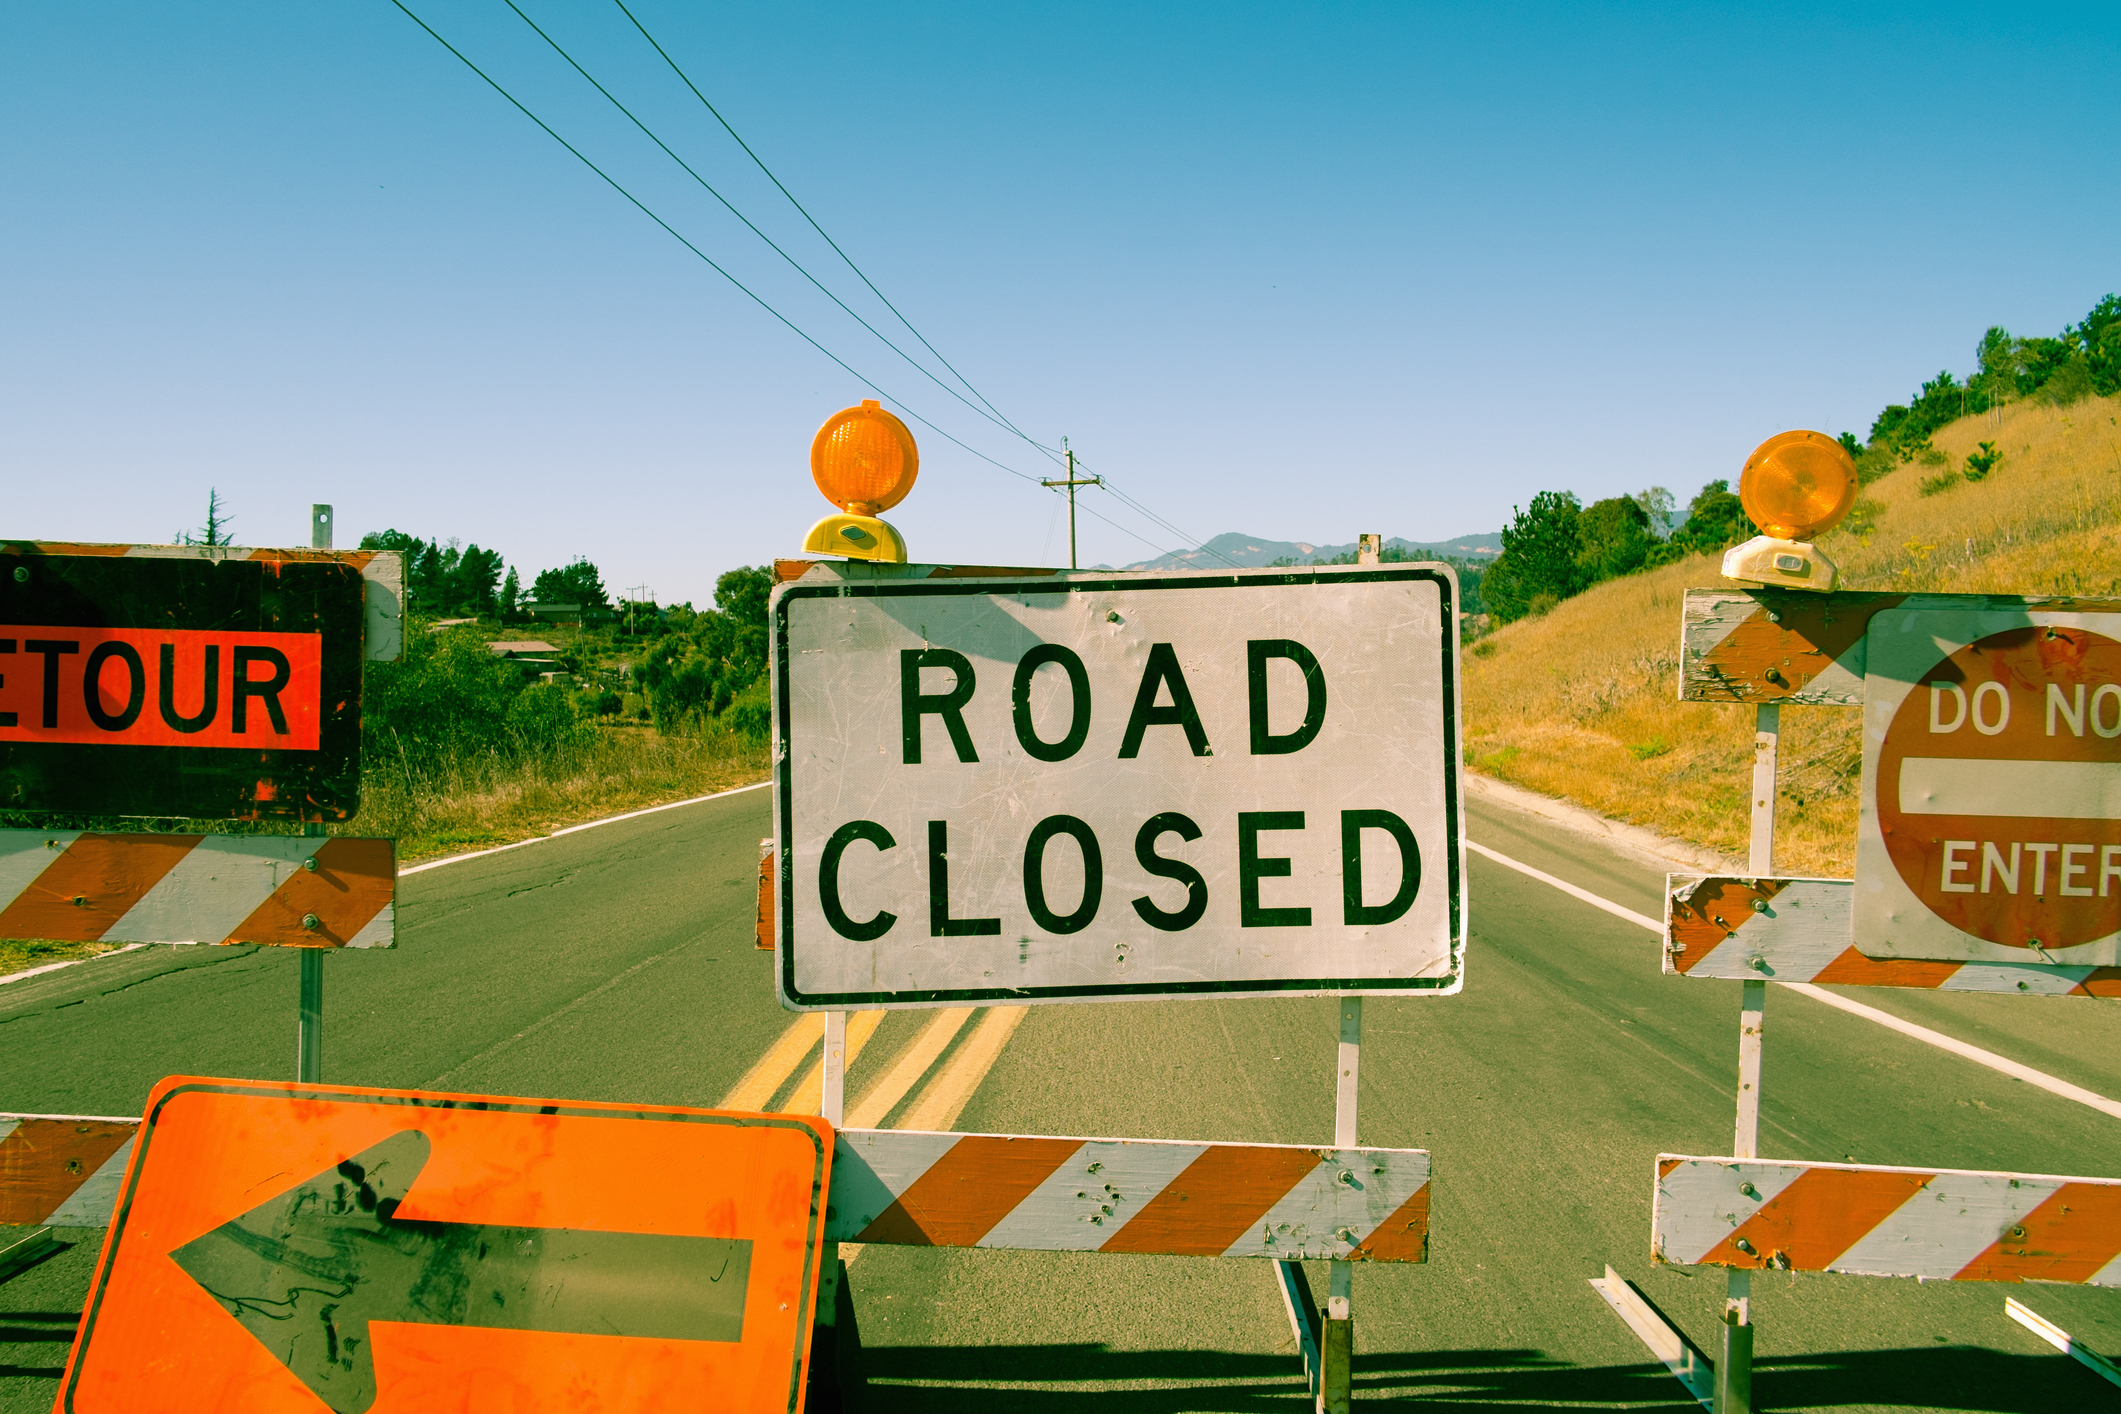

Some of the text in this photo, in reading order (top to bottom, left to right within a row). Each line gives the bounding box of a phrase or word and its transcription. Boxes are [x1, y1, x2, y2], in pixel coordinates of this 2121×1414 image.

[901, 639, 1327, 764] ROAD
[1928, 680, 2011, 736] DO
[818, 808, 1422, 941] CLOSED
[1940, 840, 2121, 897] ENTER
